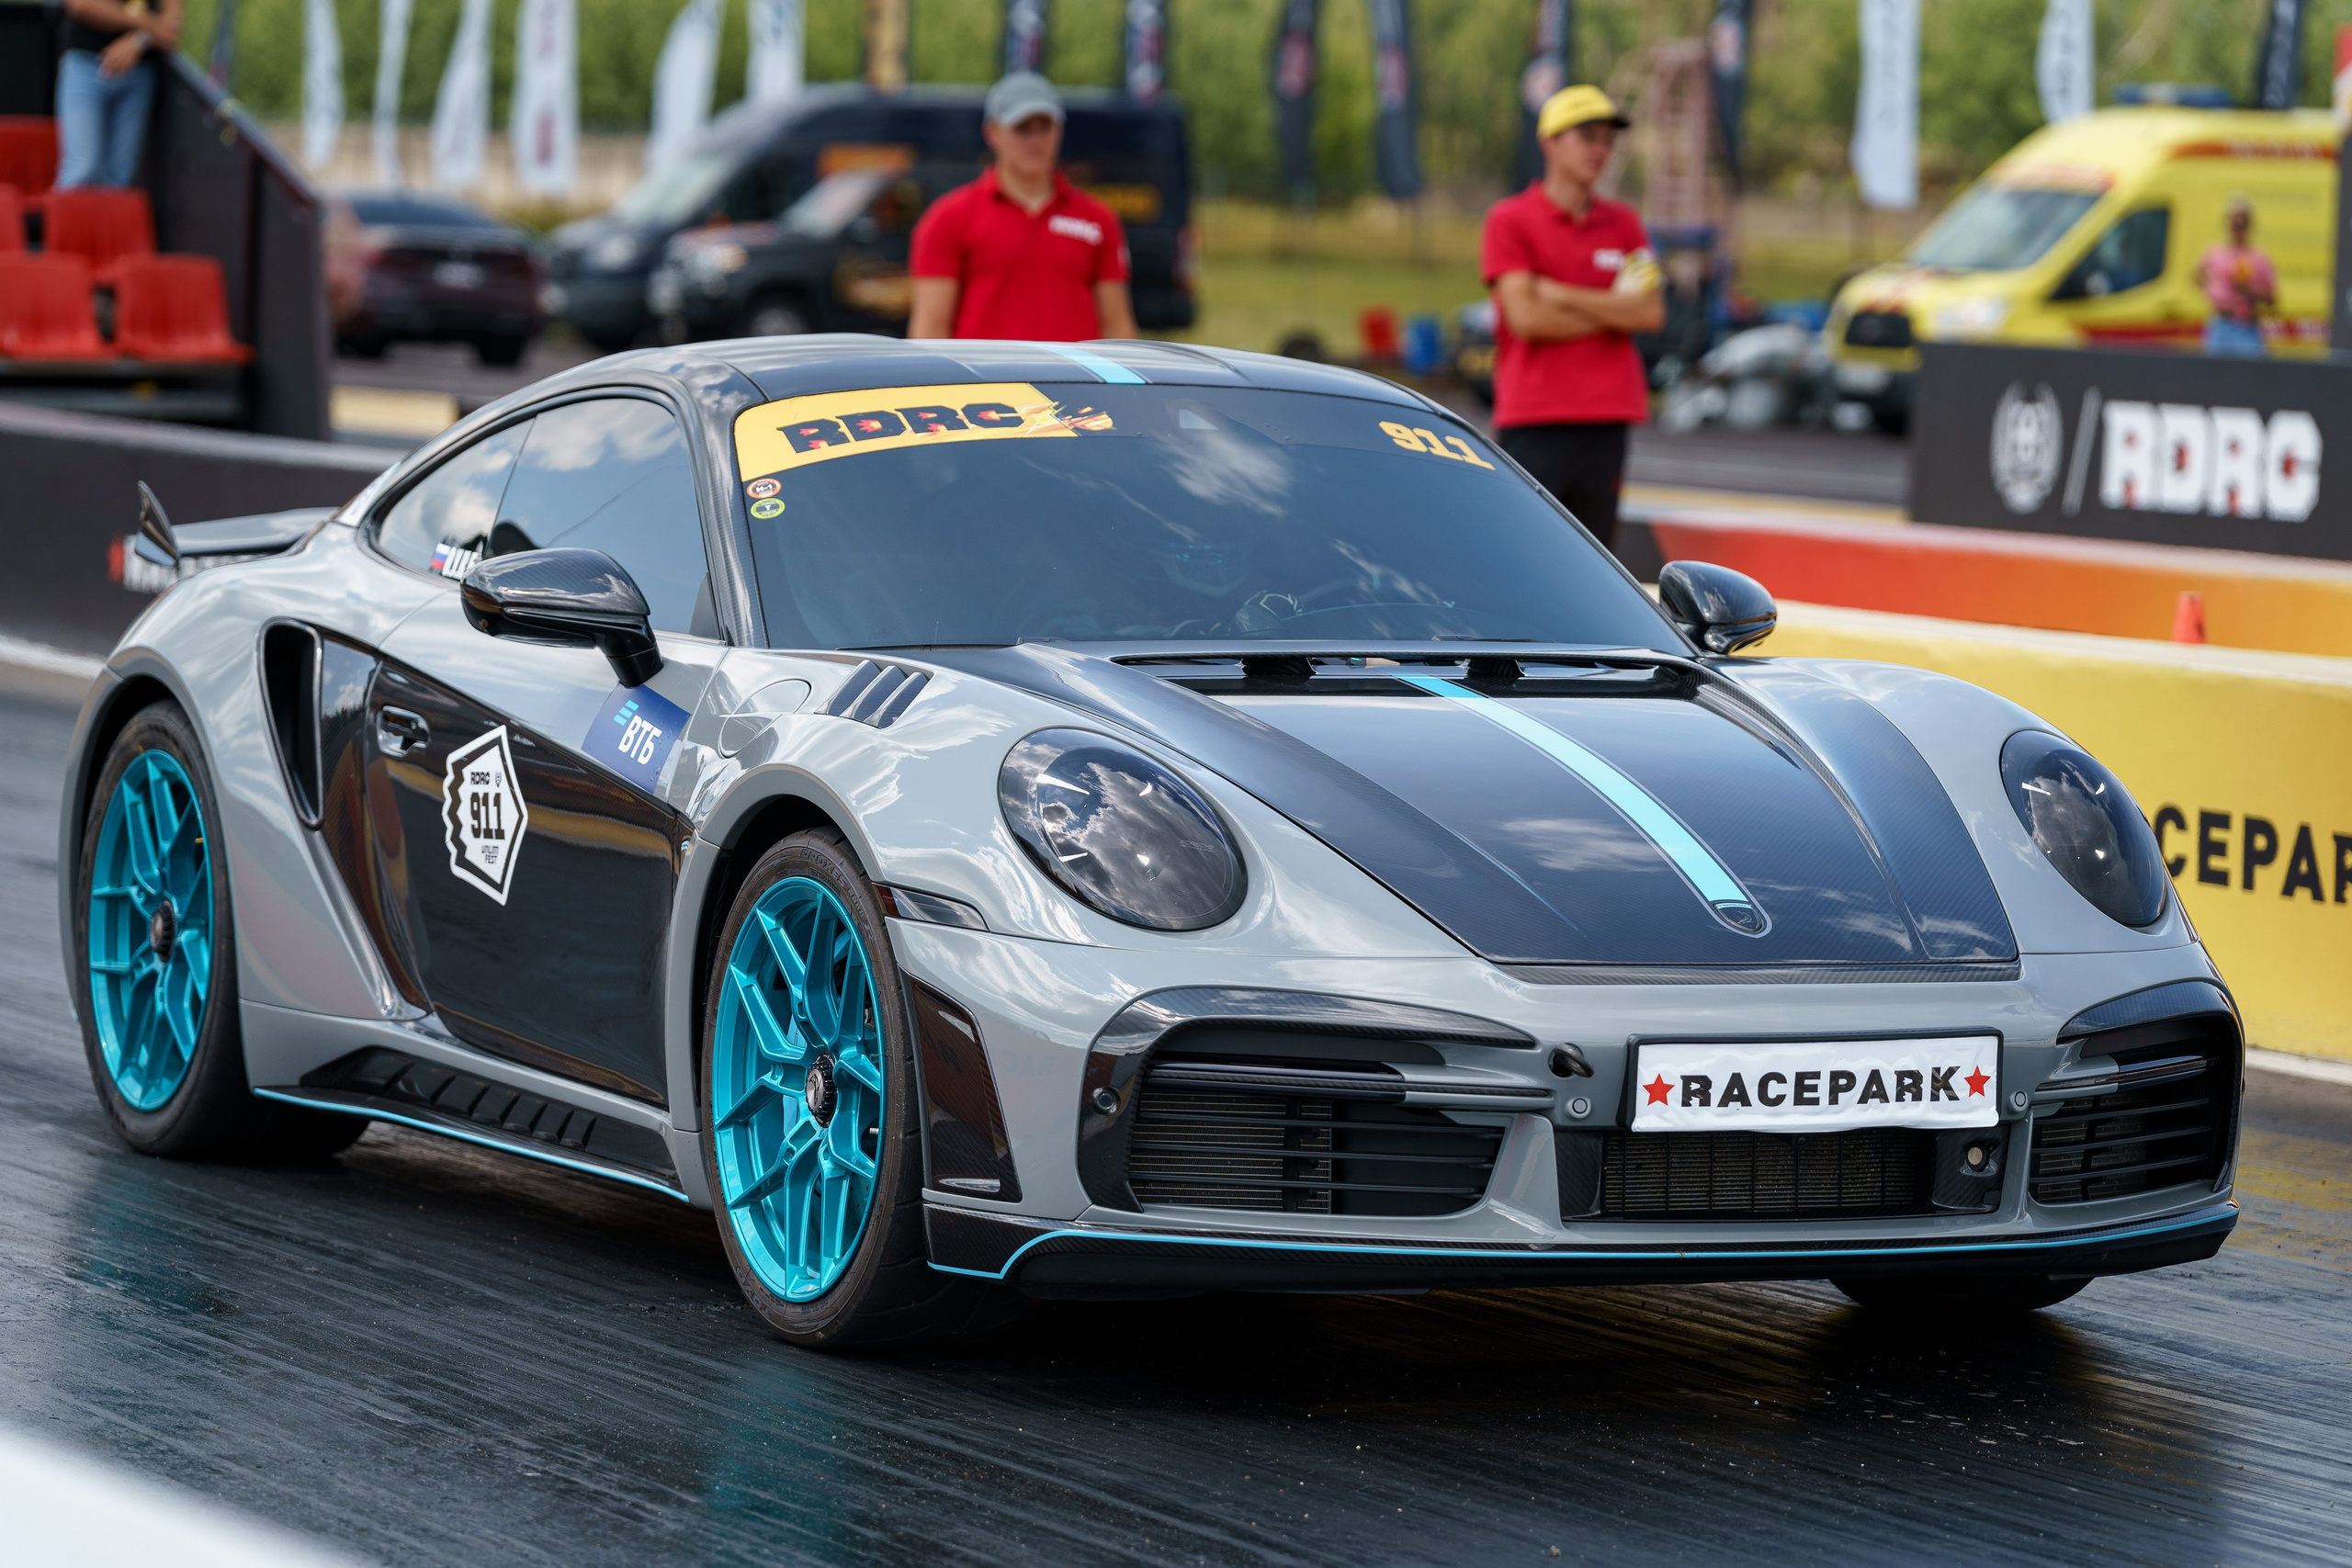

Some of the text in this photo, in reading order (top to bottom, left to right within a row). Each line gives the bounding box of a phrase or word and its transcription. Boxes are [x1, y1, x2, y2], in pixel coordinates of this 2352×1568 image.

[776, 402, 1024, 454] RDRC
[1378, 420, 1497, 470] 911
[2099, 399, 2323, 523] RDRC
[617, 715, 662, 765] ВТБ
[470, 772, 491, 785] RDRC
[470, 792, 505, 840] 911
[484, 854, 498, 864] FEST
[800, 848, 847, 888] PROXES
[1680, 1066, 1961, 1108] RACEPARK
